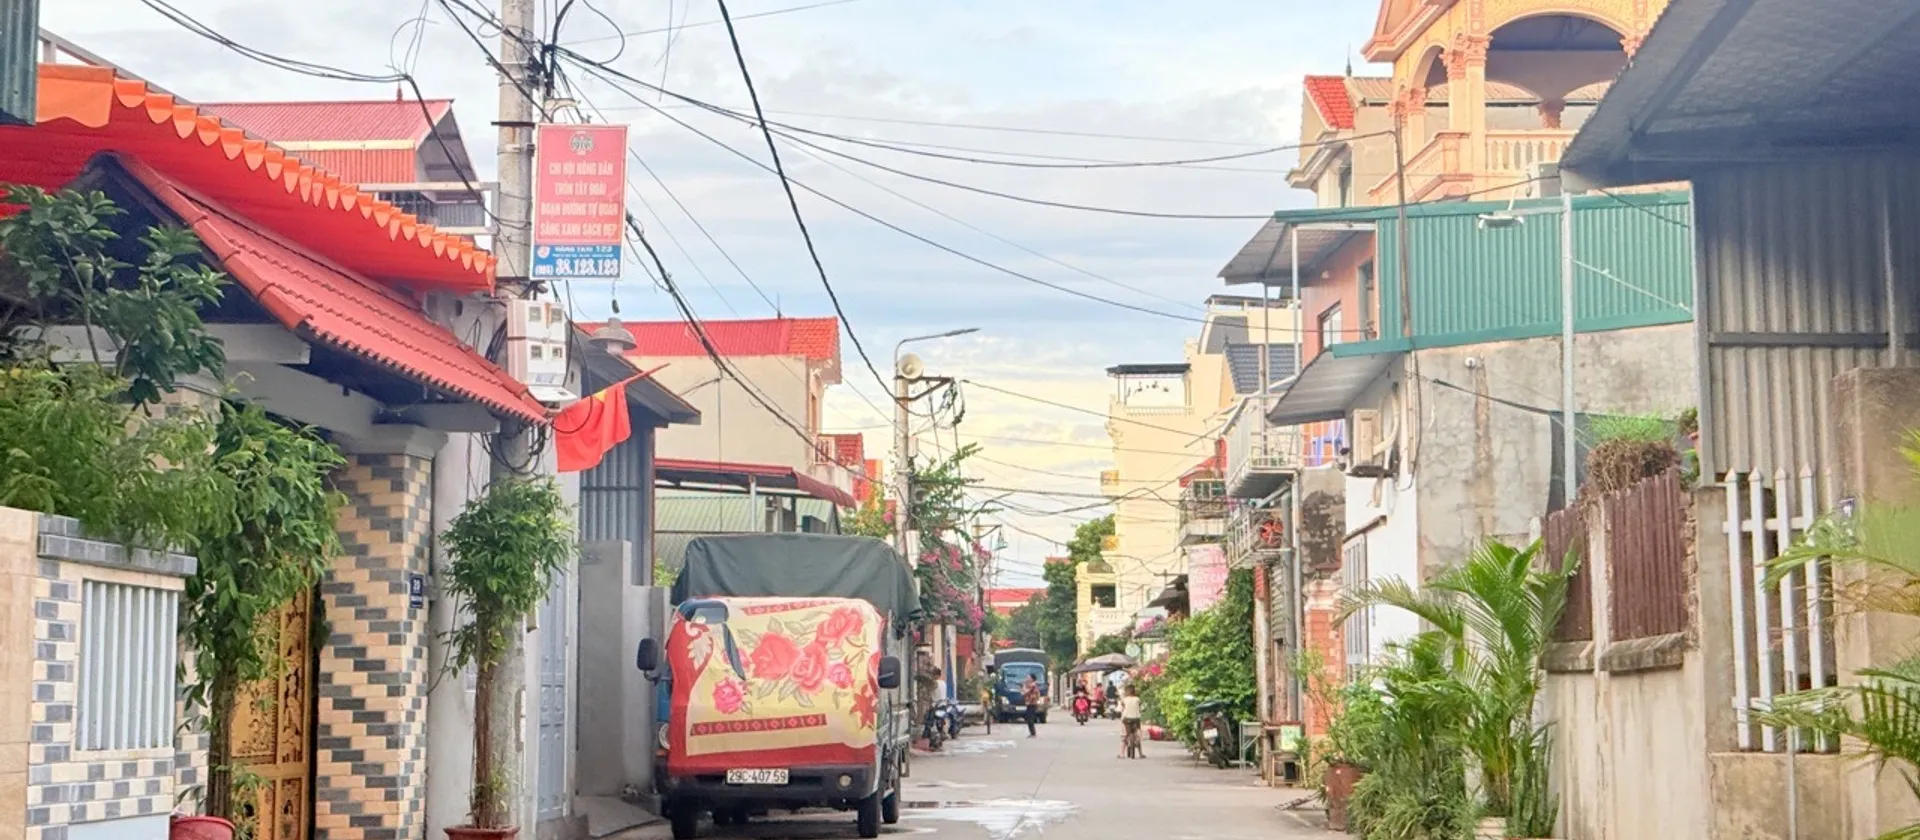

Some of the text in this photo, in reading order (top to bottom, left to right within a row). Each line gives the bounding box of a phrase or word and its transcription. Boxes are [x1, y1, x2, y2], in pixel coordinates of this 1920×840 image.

[549, 162, 562, 175] CHI
[562, 160, 576, 178] HỘI
[576, 160, 597, 175] NÔNG
[555, 180, 573, 196] THÔN
[561, 223, 581, 236] XANH
[595, 245, 613, 253] 123
[555, 258, 619, 276] 38.123.123
